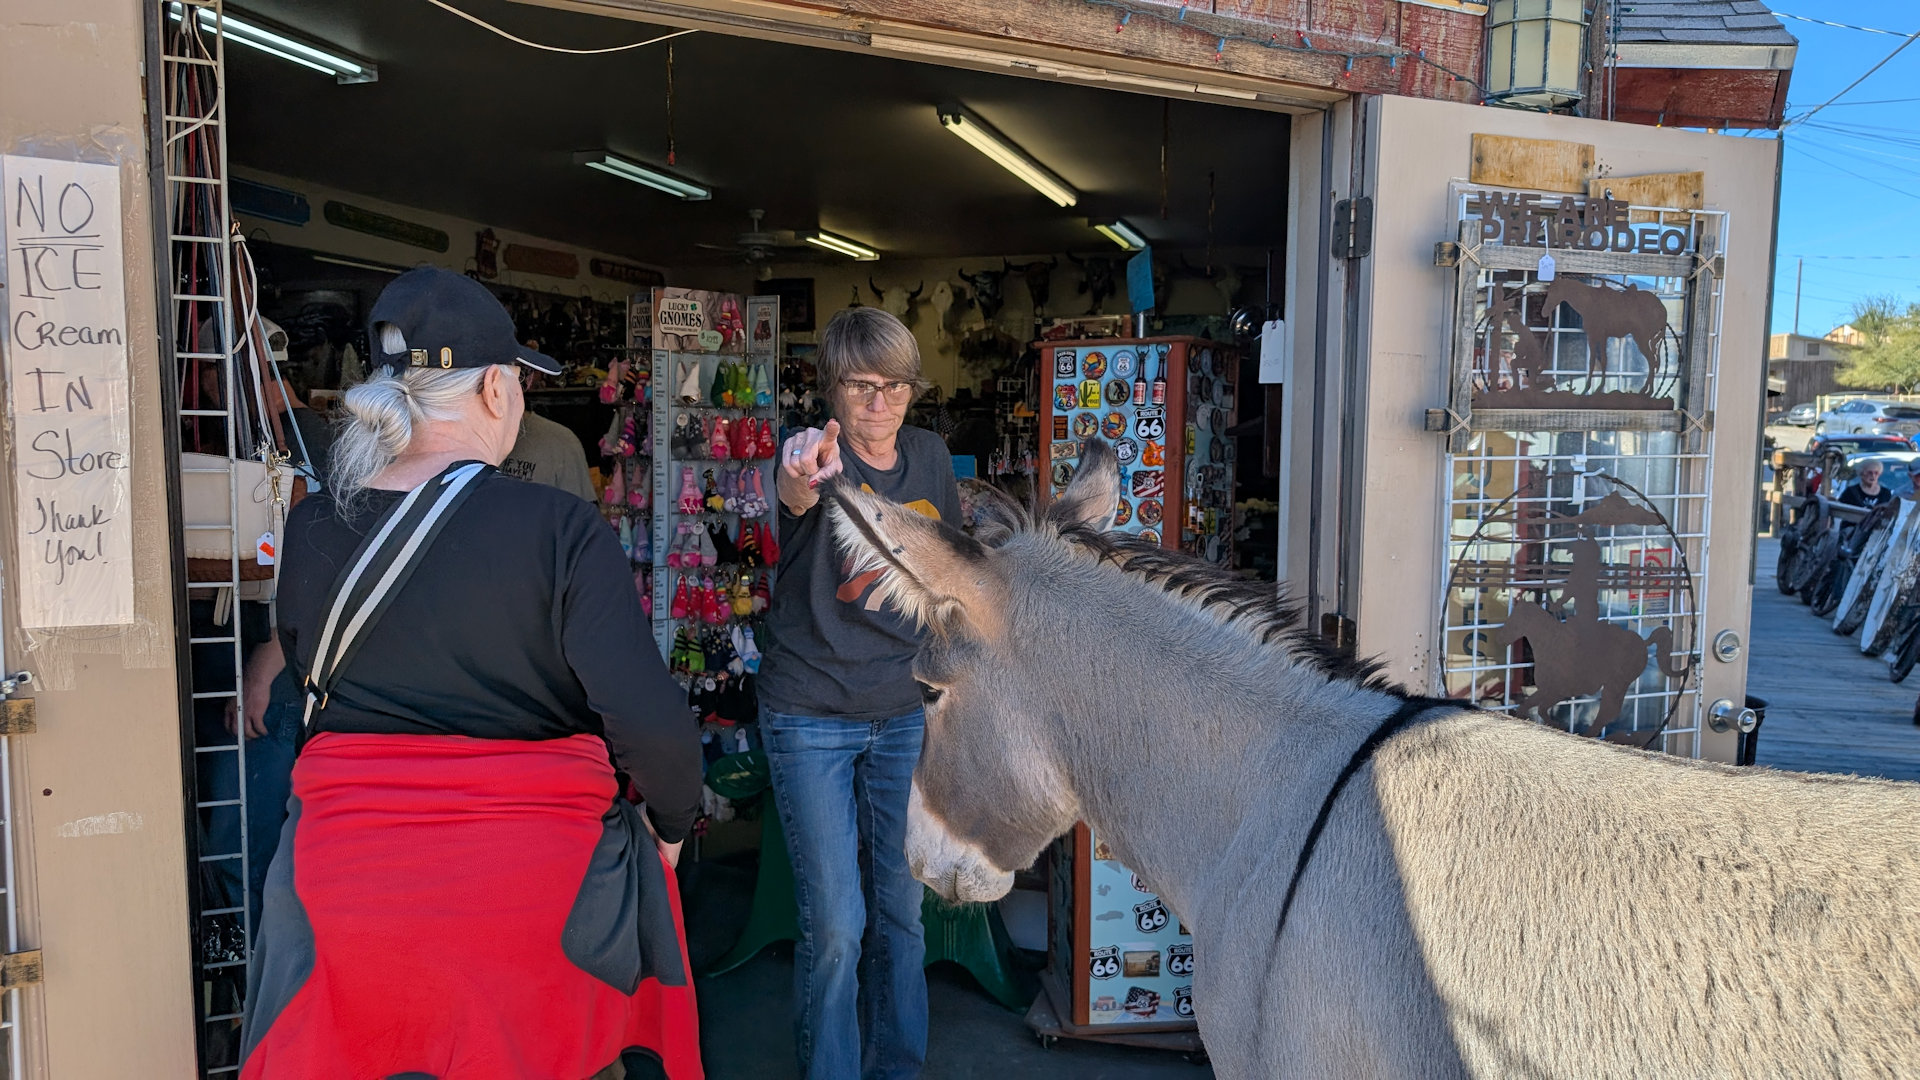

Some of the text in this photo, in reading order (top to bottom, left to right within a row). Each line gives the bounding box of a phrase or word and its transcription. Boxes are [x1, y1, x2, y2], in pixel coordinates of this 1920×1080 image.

[17, 174, 95, 235] NO
[1477, 190, 1629, 226] WE ARE
[1557, 223, 1686, 256] RODEO
[12, 245, 102, 300] ICE
[668, 302, 689, 311] LUCKY
[660, 310, 702, 328] GNOMES
[1060, 362, 1072, 371] 66
[25, 367, 94, 412] IN
[1058, 397, 1072, 408] 66
[1137, 418, 1163, 437] 66
[26, 428, 127, 480] Store
[1121, 450, 1129, 458] 66
[517, 460, 537, 472] YOU
[28, 497, 111, 535] Thank
[45, 532, 108, 585] You!
[1139, 902, 1157, 912] ROUTE
[1141, 909, 1166, 930] 66
[1093, 949, 1112, 957] ROUTE
[1092, 957, 1118, 977] 66
[1171, 955, 1194, 973] 66
